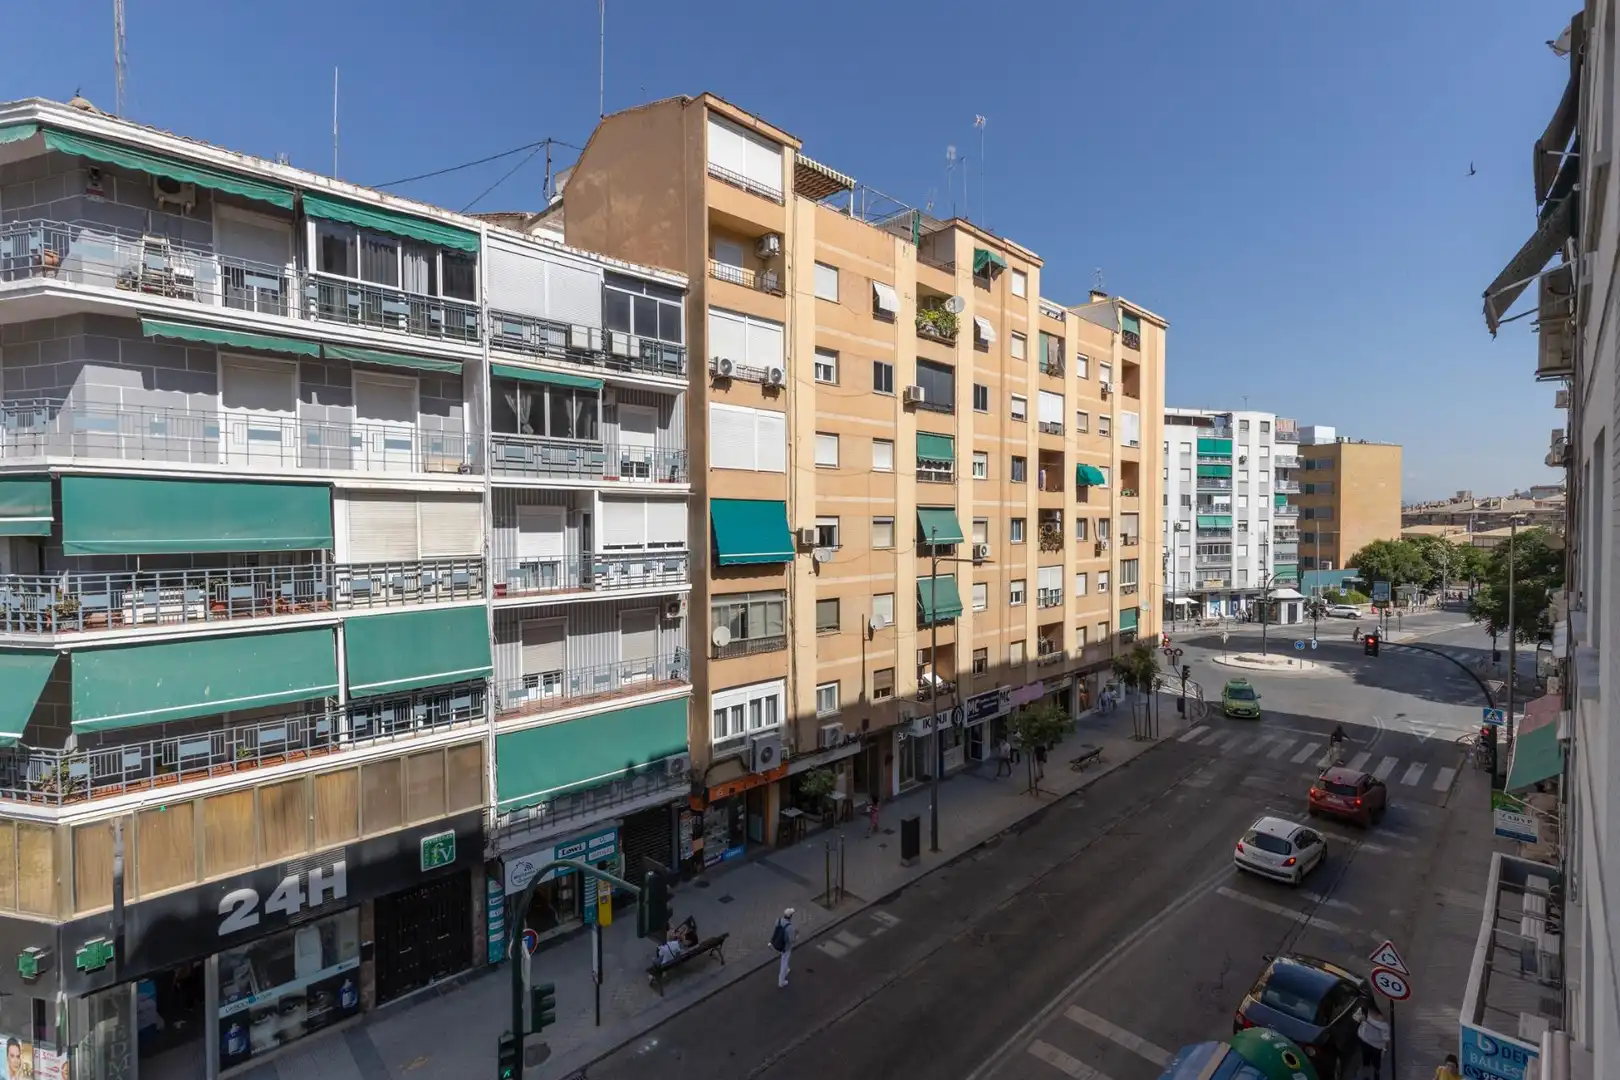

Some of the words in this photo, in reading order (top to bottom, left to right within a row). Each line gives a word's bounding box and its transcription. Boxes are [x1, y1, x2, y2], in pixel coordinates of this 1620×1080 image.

[922, 712, 948, 730] IKNJI
[561, 844, 582, 856] Lowi
[218, 860, 347, 936] 24H
[1379, 976, 1403, 992] 30
